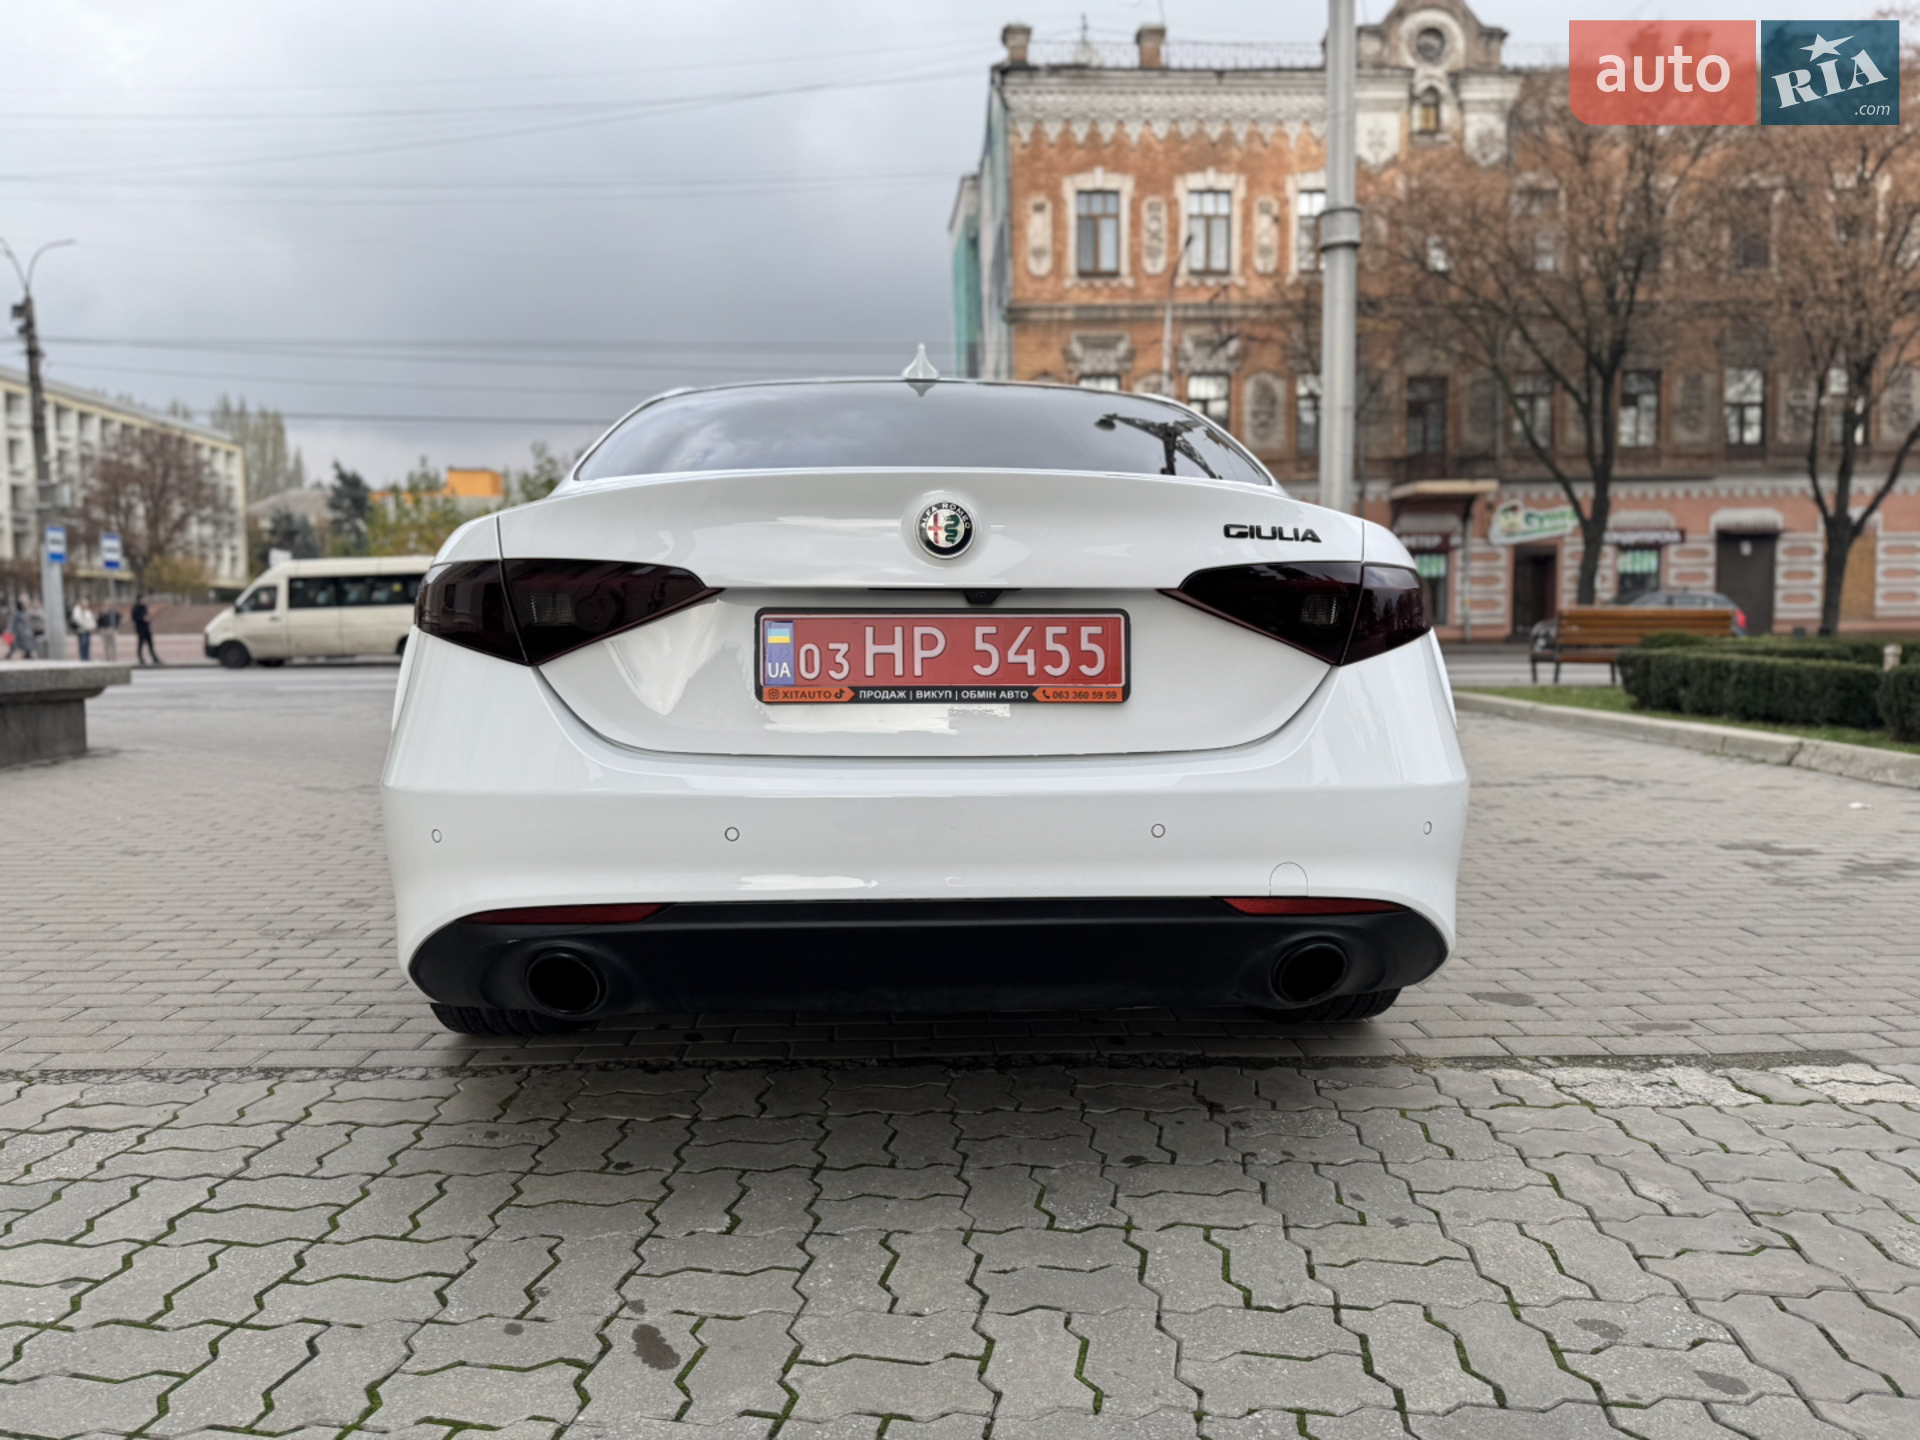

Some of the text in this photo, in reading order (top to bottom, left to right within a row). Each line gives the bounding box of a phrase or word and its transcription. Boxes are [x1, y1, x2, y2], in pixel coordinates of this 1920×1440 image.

[920, 506, 938, 528] ALFA
[1223, 523, 1322, 544] GIULIA
[800, 626, 1105, 680] 03 HP 5455
[768, 662, 792, 678] UA
[782, 690, 832, 700] XITAUTO
[859, 690, 1029, 700] ПРОДАЖ ВИКУП ОБМІН АВТО
